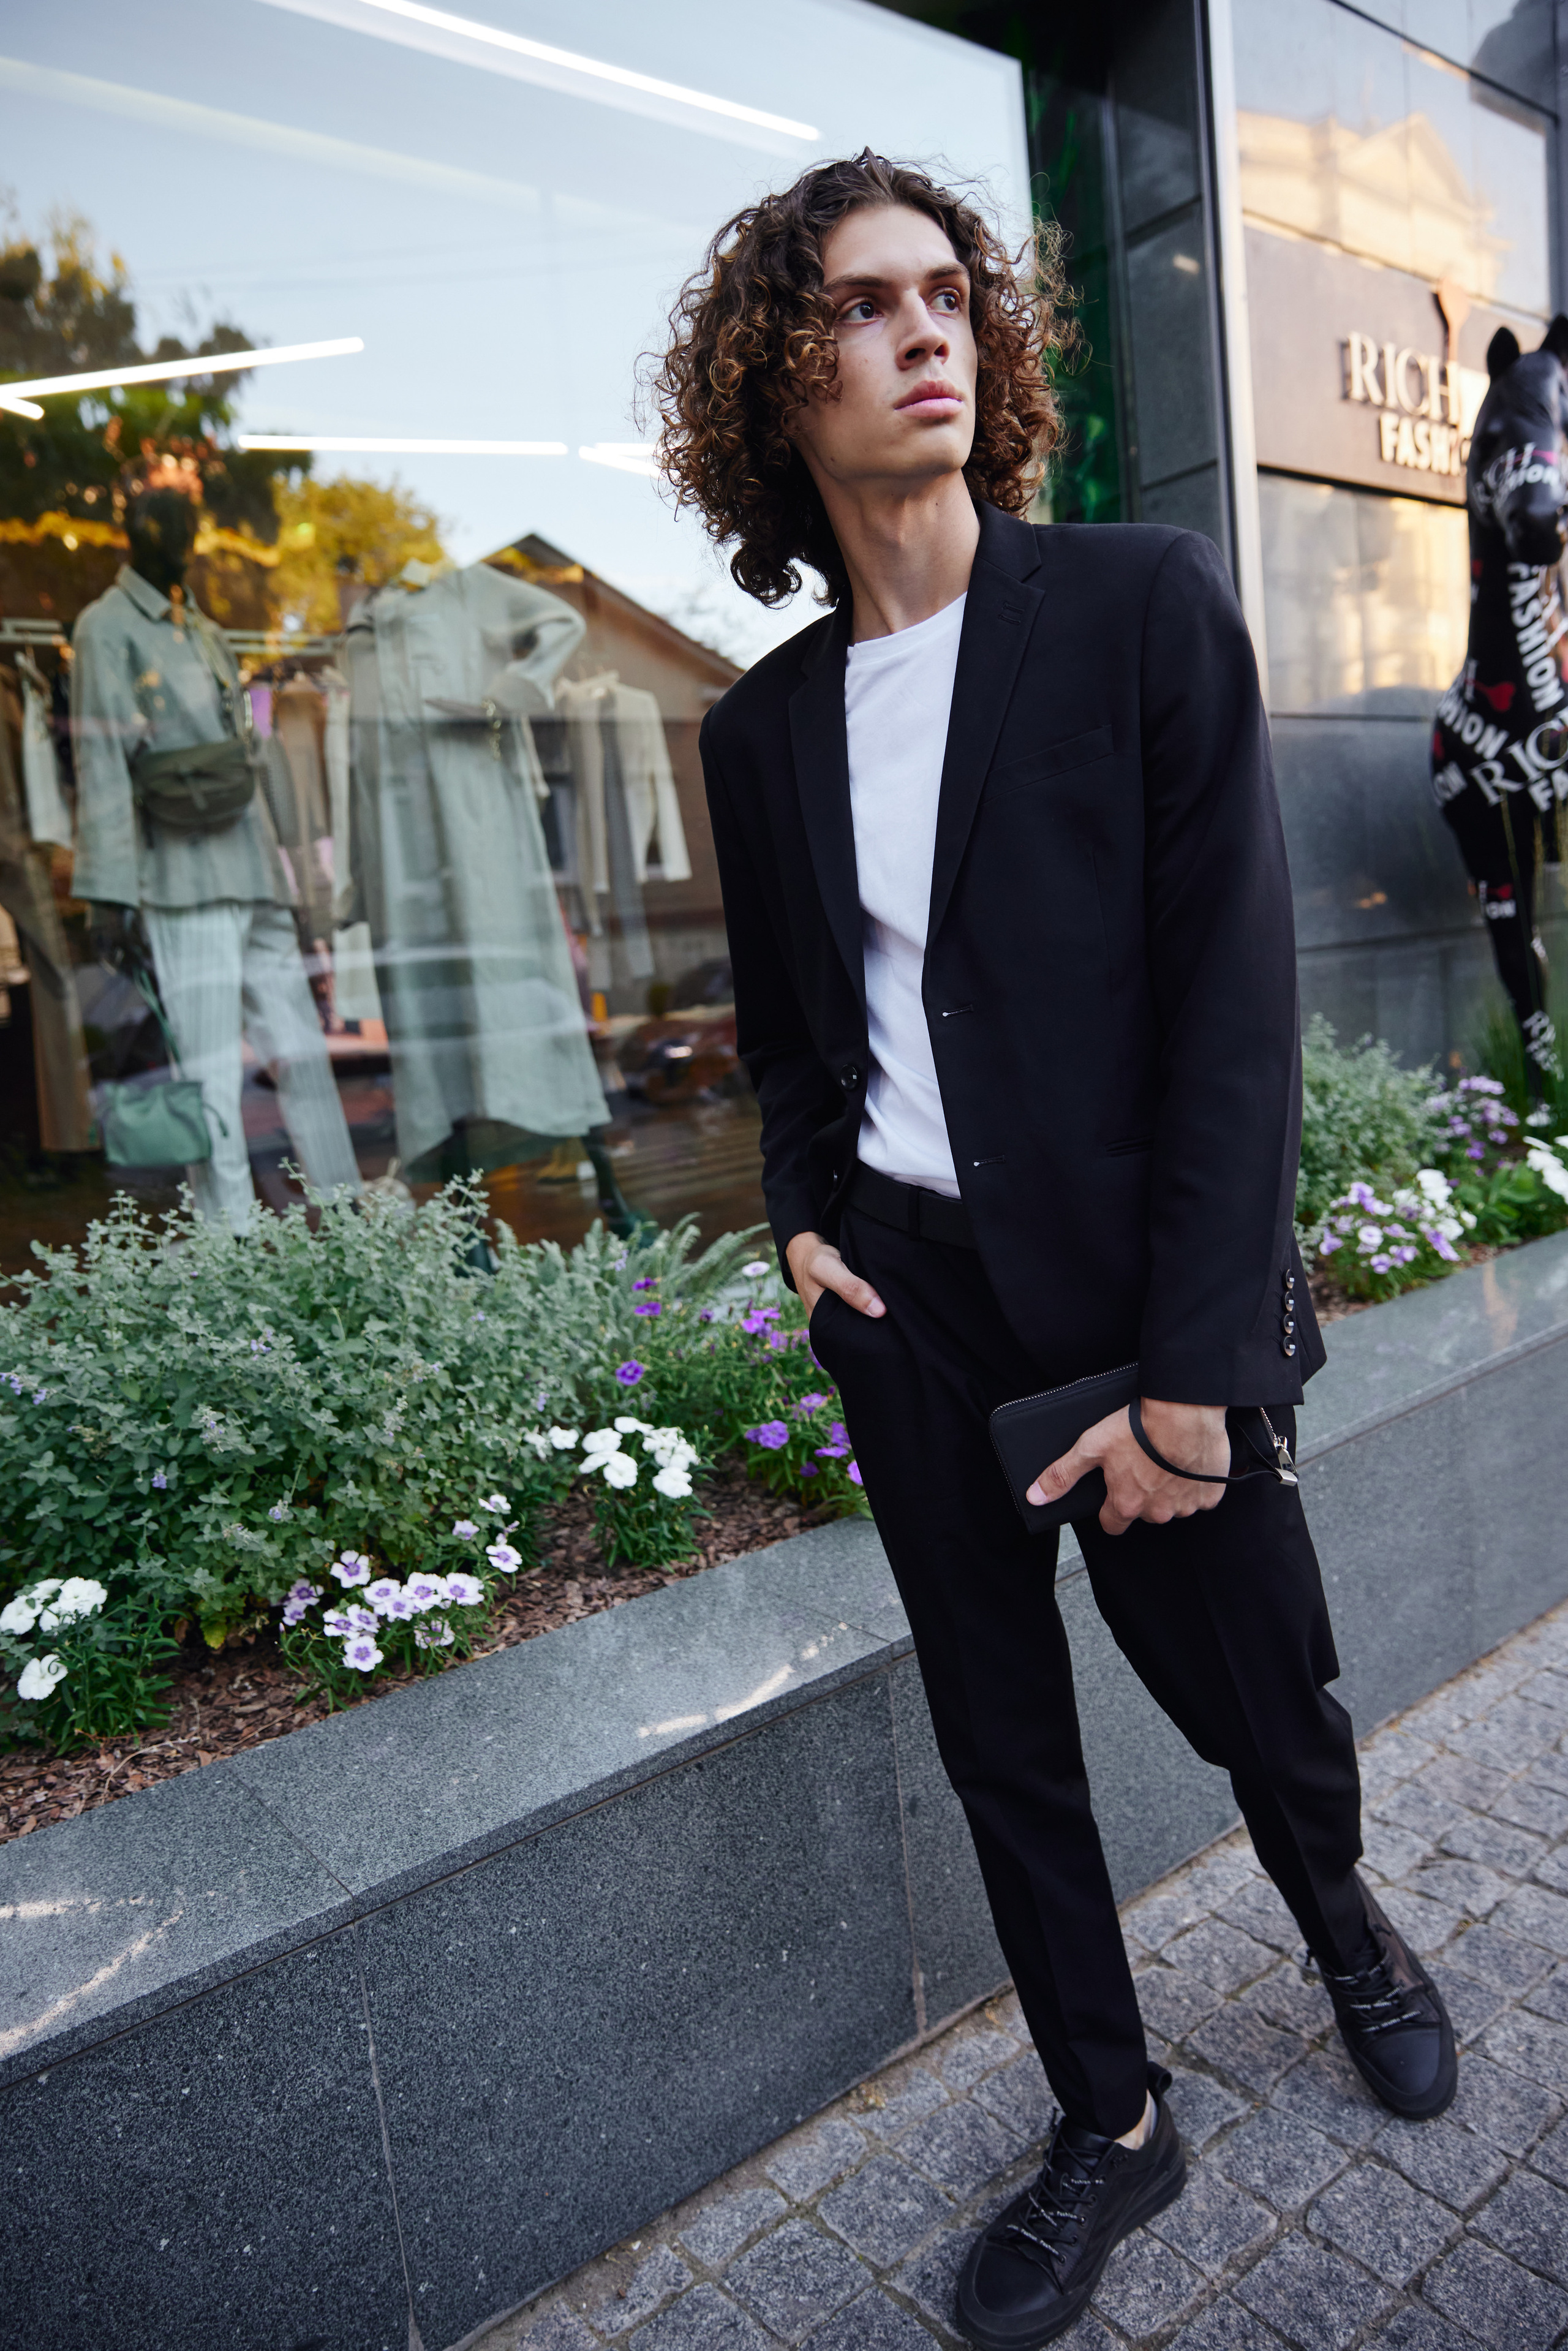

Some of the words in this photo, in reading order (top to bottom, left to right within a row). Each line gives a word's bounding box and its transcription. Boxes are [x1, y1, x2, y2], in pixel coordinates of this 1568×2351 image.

[1348, 330, 1460, 425] RICH
[1379, 411, 1471, 477] FASHI
[1506, 561, 1565, 713] FASHION
[1468, 704, 1568, 807] RIC
